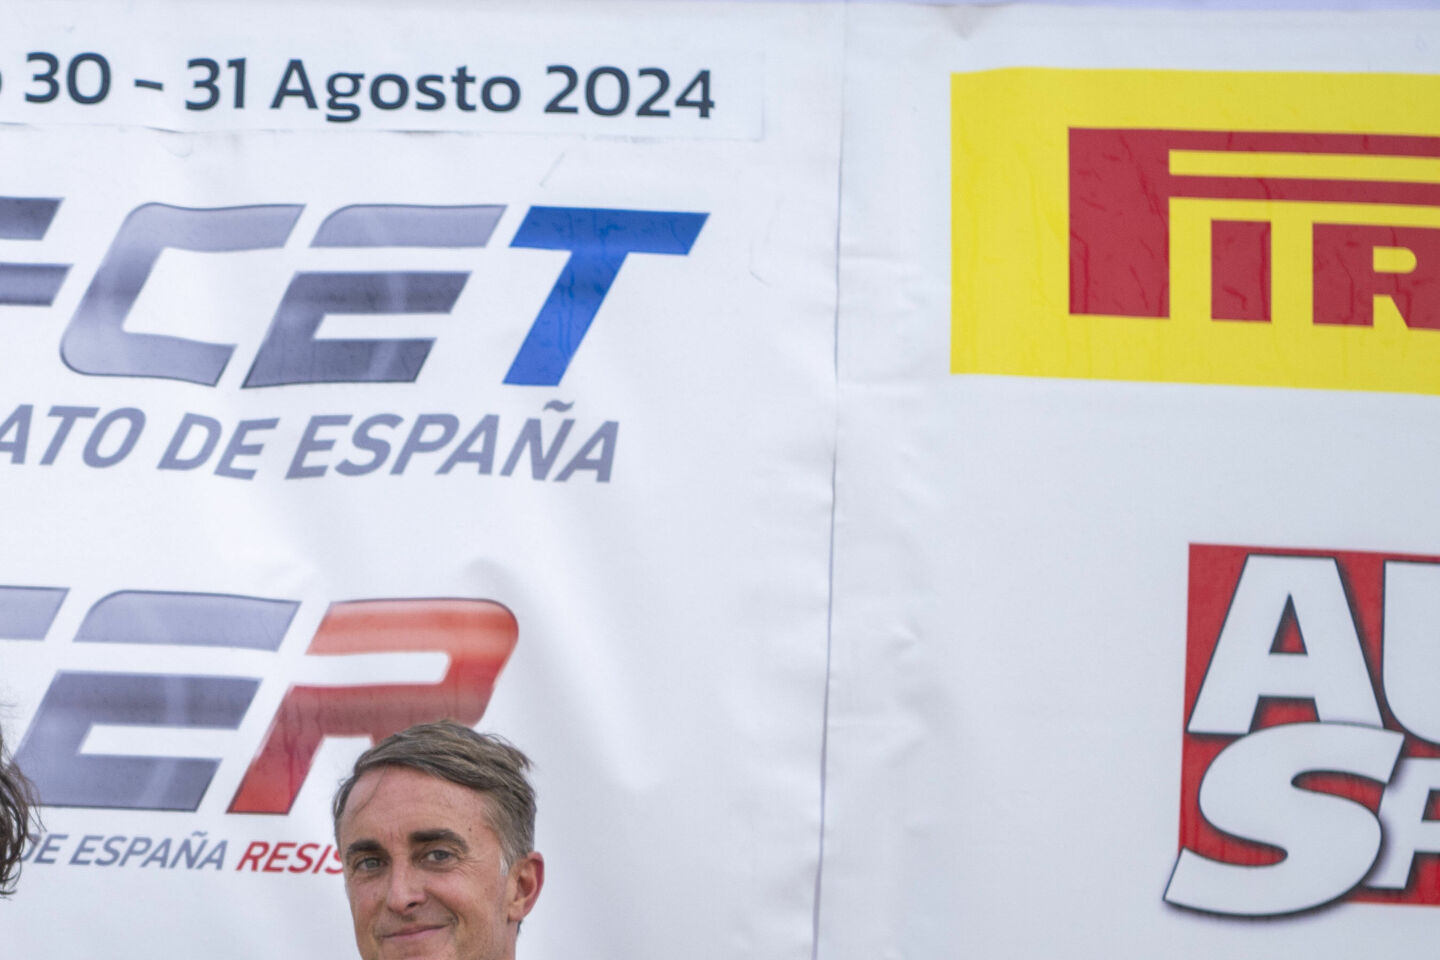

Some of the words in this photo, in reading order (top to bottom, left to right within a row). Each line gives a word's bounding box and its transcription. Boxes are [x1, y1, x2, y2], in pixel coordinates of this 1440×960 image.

[24, 51, 112, 104] 30
[184, 57, 247, 111] 31
[269, 58, 522, 123] Agosto
[544, 64, 716, 118] 2024
[156, 412, 280, 480] DE
[284, 399, 620, 483] ESPAÑA
[69, 830, 228, 870] ESPAÑA
